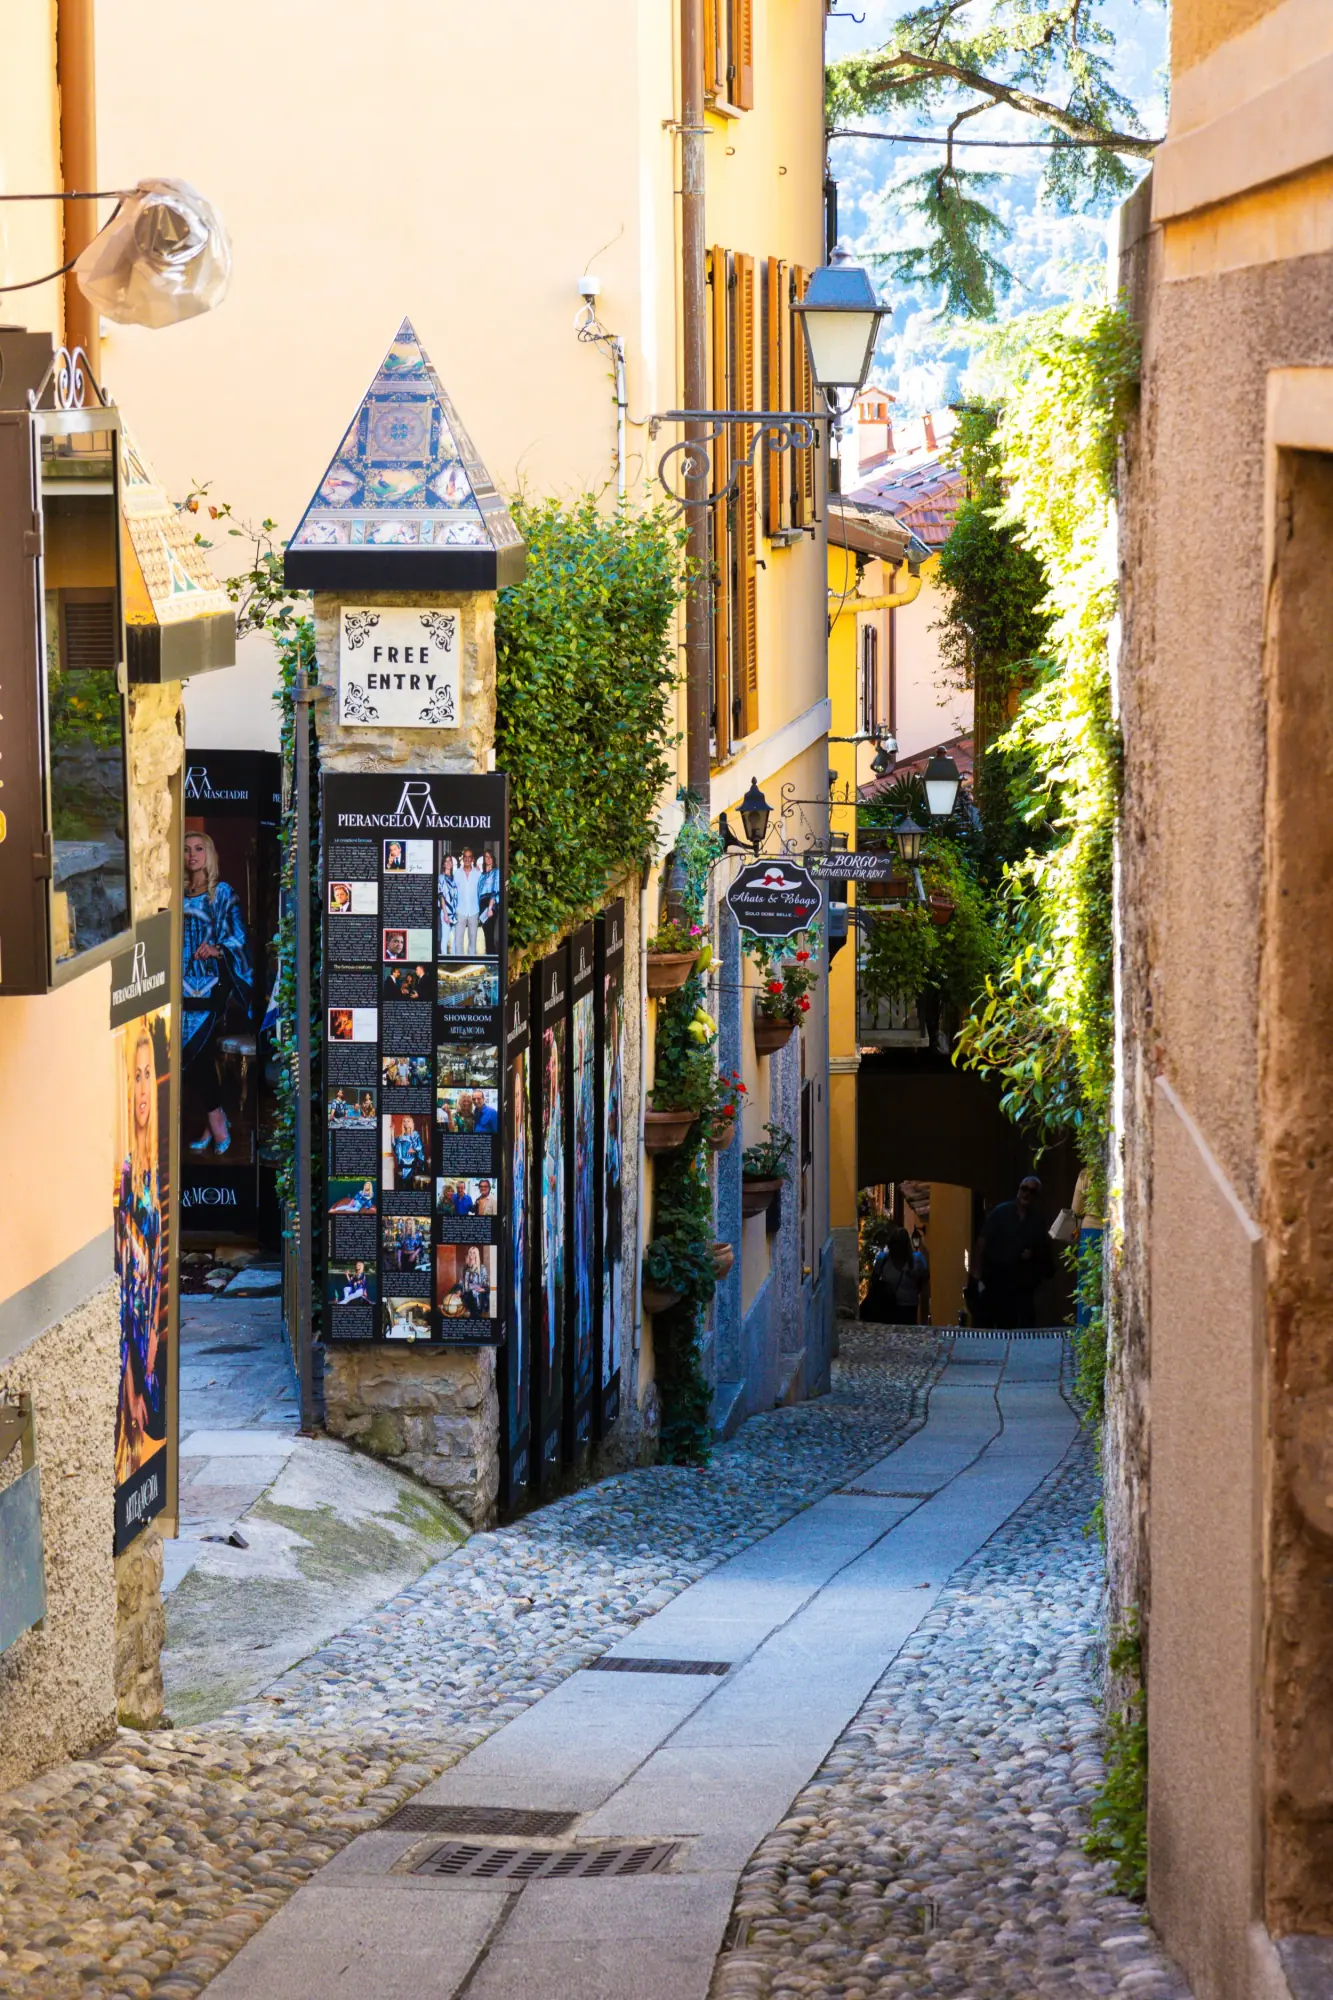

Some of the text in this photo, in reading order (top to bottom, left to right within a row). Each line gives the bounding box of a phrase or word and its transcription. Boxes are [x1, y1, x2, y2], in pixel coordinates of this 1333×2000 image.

[373, 646, 429, 664] FREE
[367, 673, 437, 690] ENTRY
[203, 789, 249, 800] MASCIADRI
[338, 814, 491, 829] PIERANGELO MASCIADRI
[835, 855, 877, 869] BORGO
[852, 869, 866, 879] FOR
[866, 869, 886, 879] RENT
[767, 893, 778, 904] &
[443, 1014, 492, 1022] SHOWROOM
